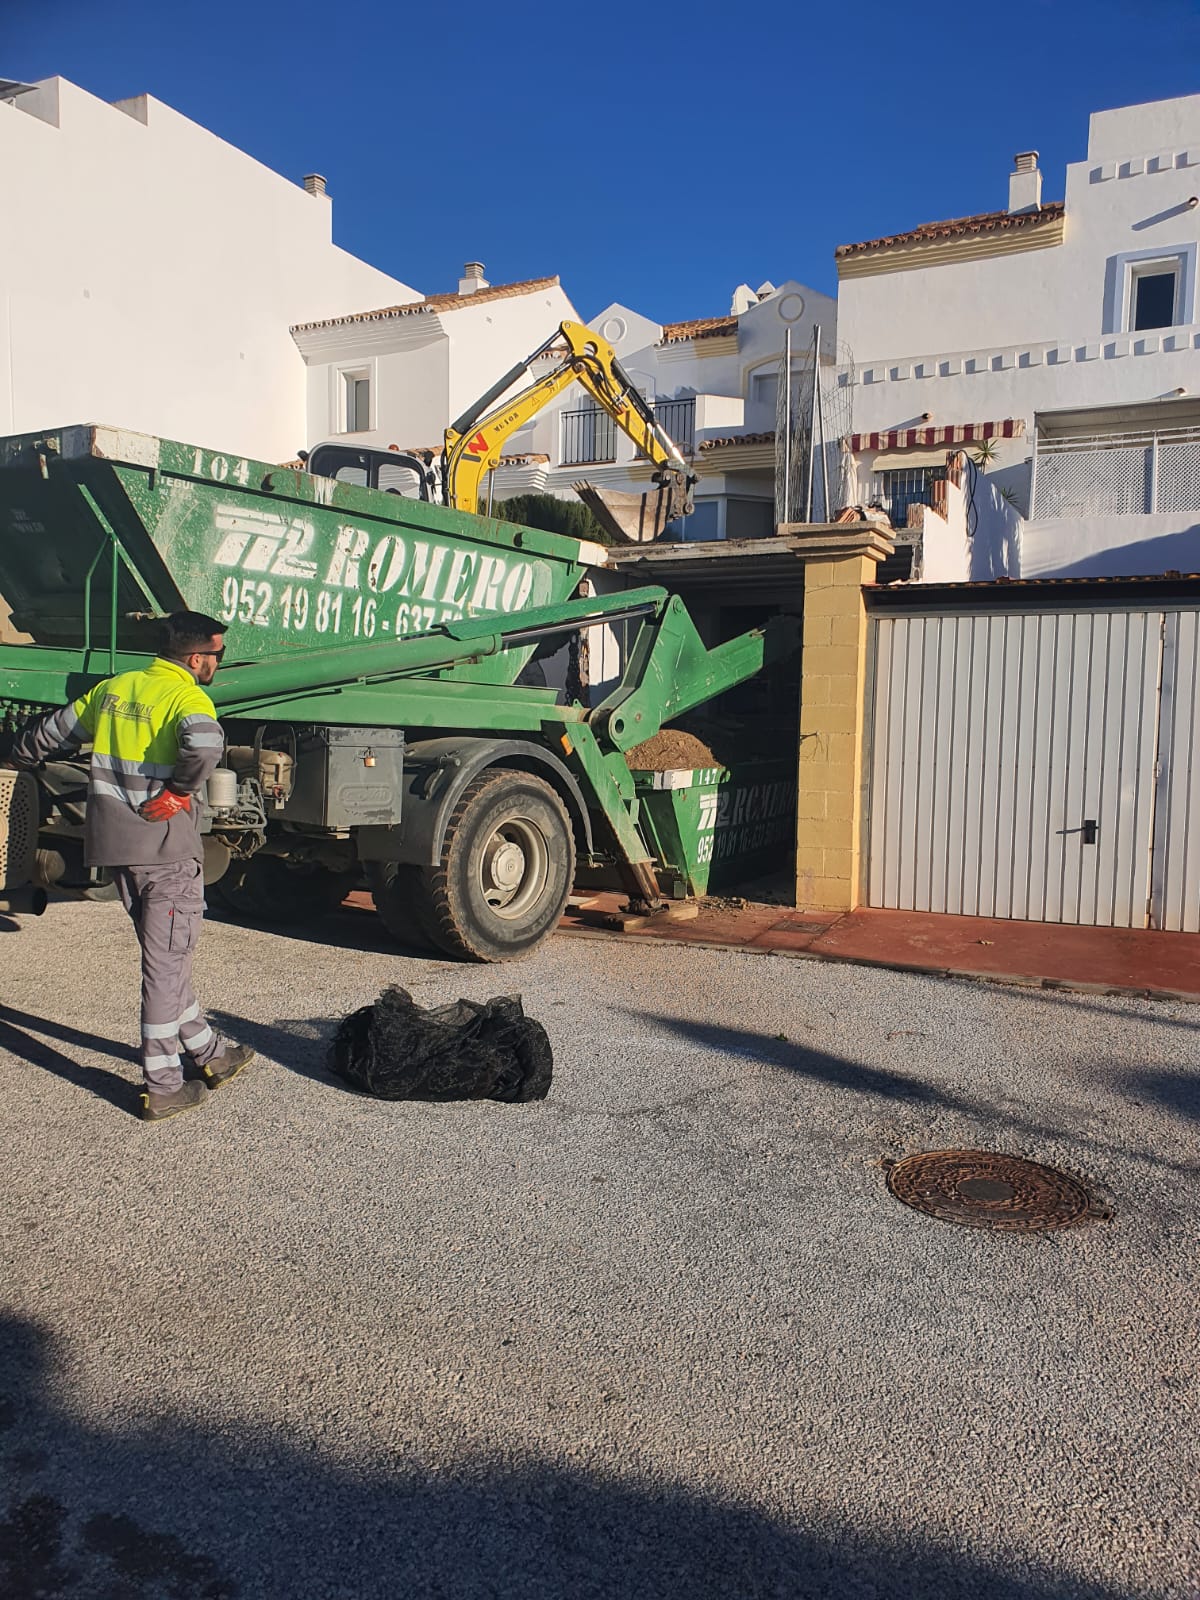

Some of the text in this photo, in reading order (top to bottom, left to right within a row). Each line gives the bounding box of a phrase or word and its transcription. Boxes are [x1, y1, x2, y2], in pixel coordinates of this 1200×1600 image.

[192, 448, 249, 486] 104
[322, 524, 534, 613] ROMERO
[222, 576, 273, 627] 952
[280, 584, 309, 631] 19
[315, 591, 343, 634] 81
[352, 595, 377, 638] 16
[698, 769, 718, 785] 147
